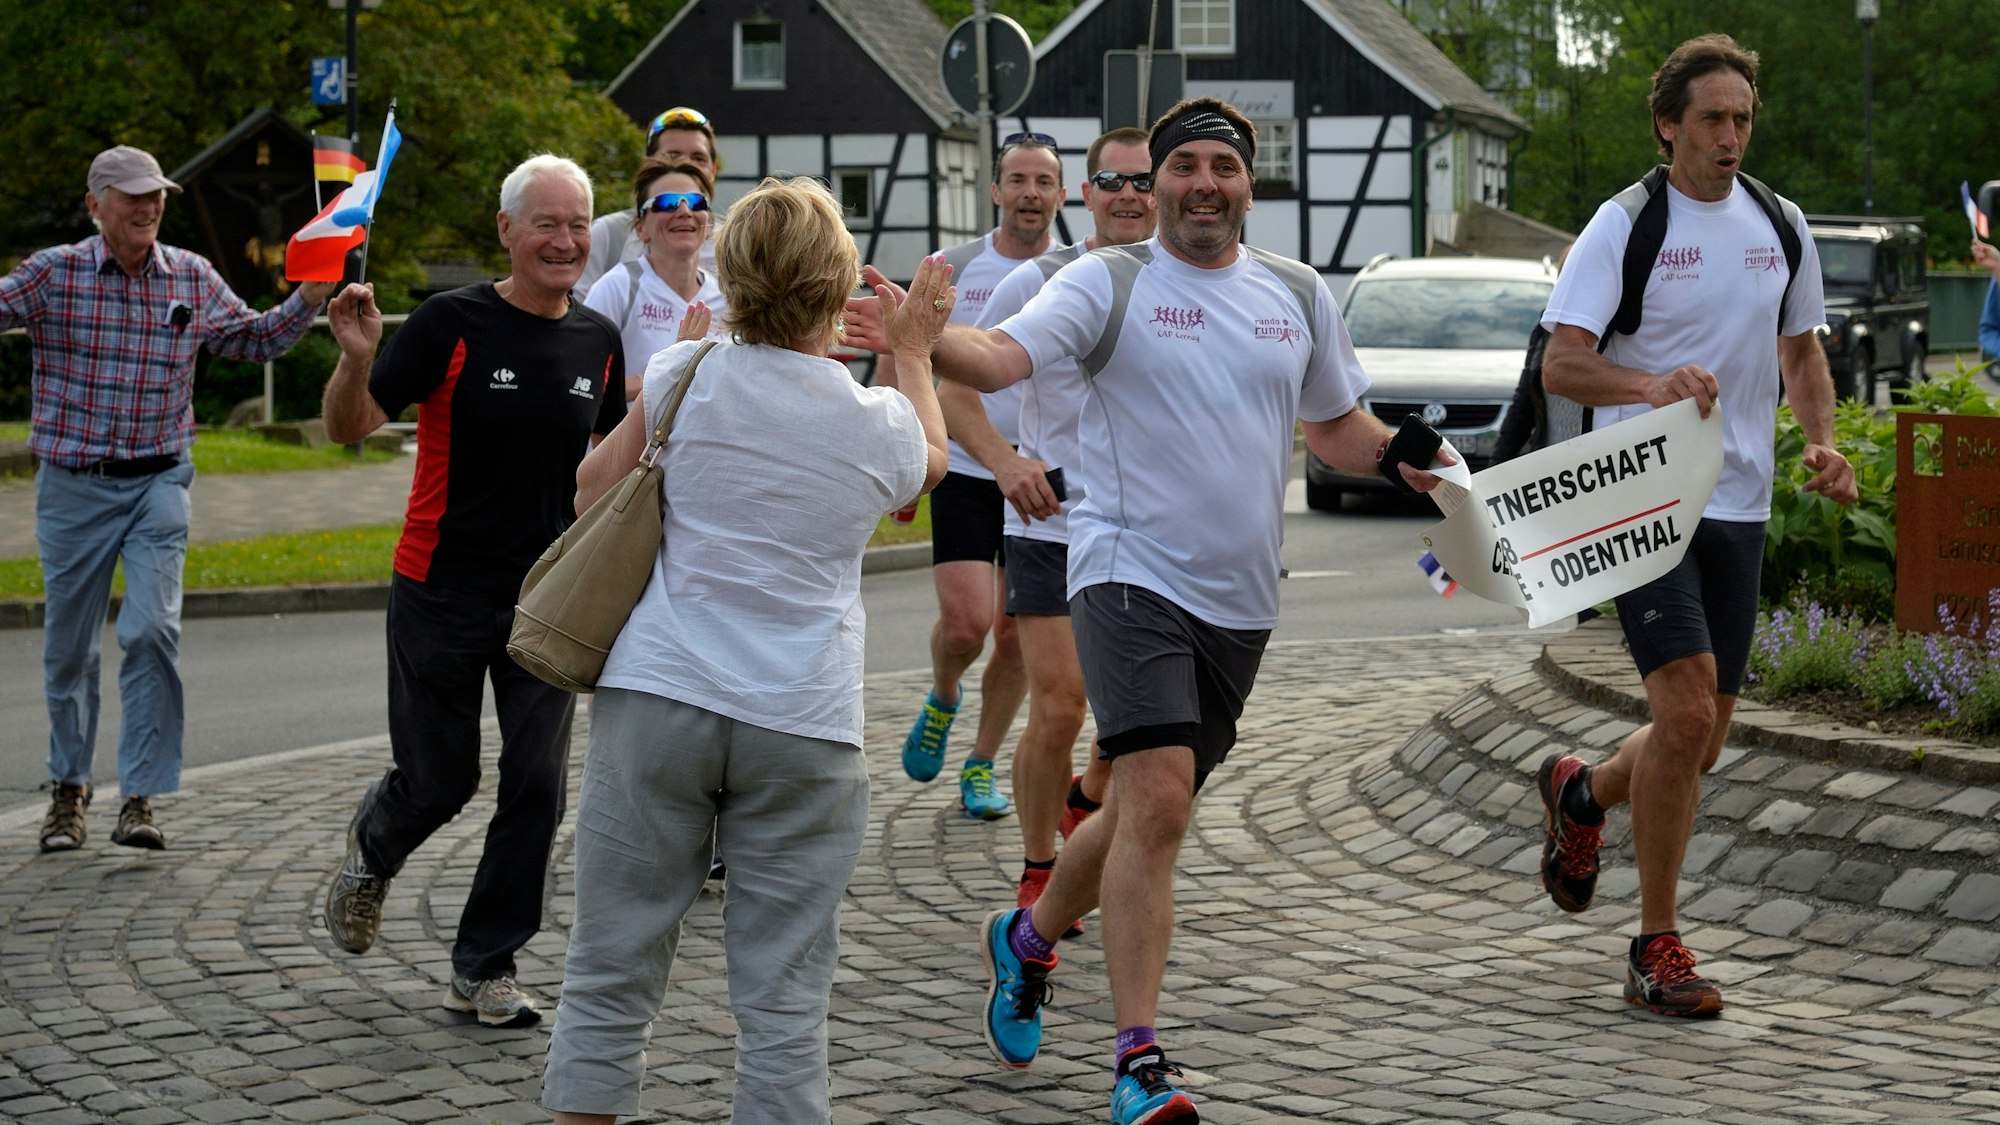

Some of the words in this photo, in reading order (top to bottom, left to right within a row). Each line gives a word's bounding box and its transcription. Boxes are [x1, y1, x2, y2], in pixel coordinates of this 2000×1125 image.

[1255, 317, 1280, 326] rando
[1486, 435, 1667, 528] TNERSCHAFT
[1550, 516, 1681, 587] ODENTHAL
